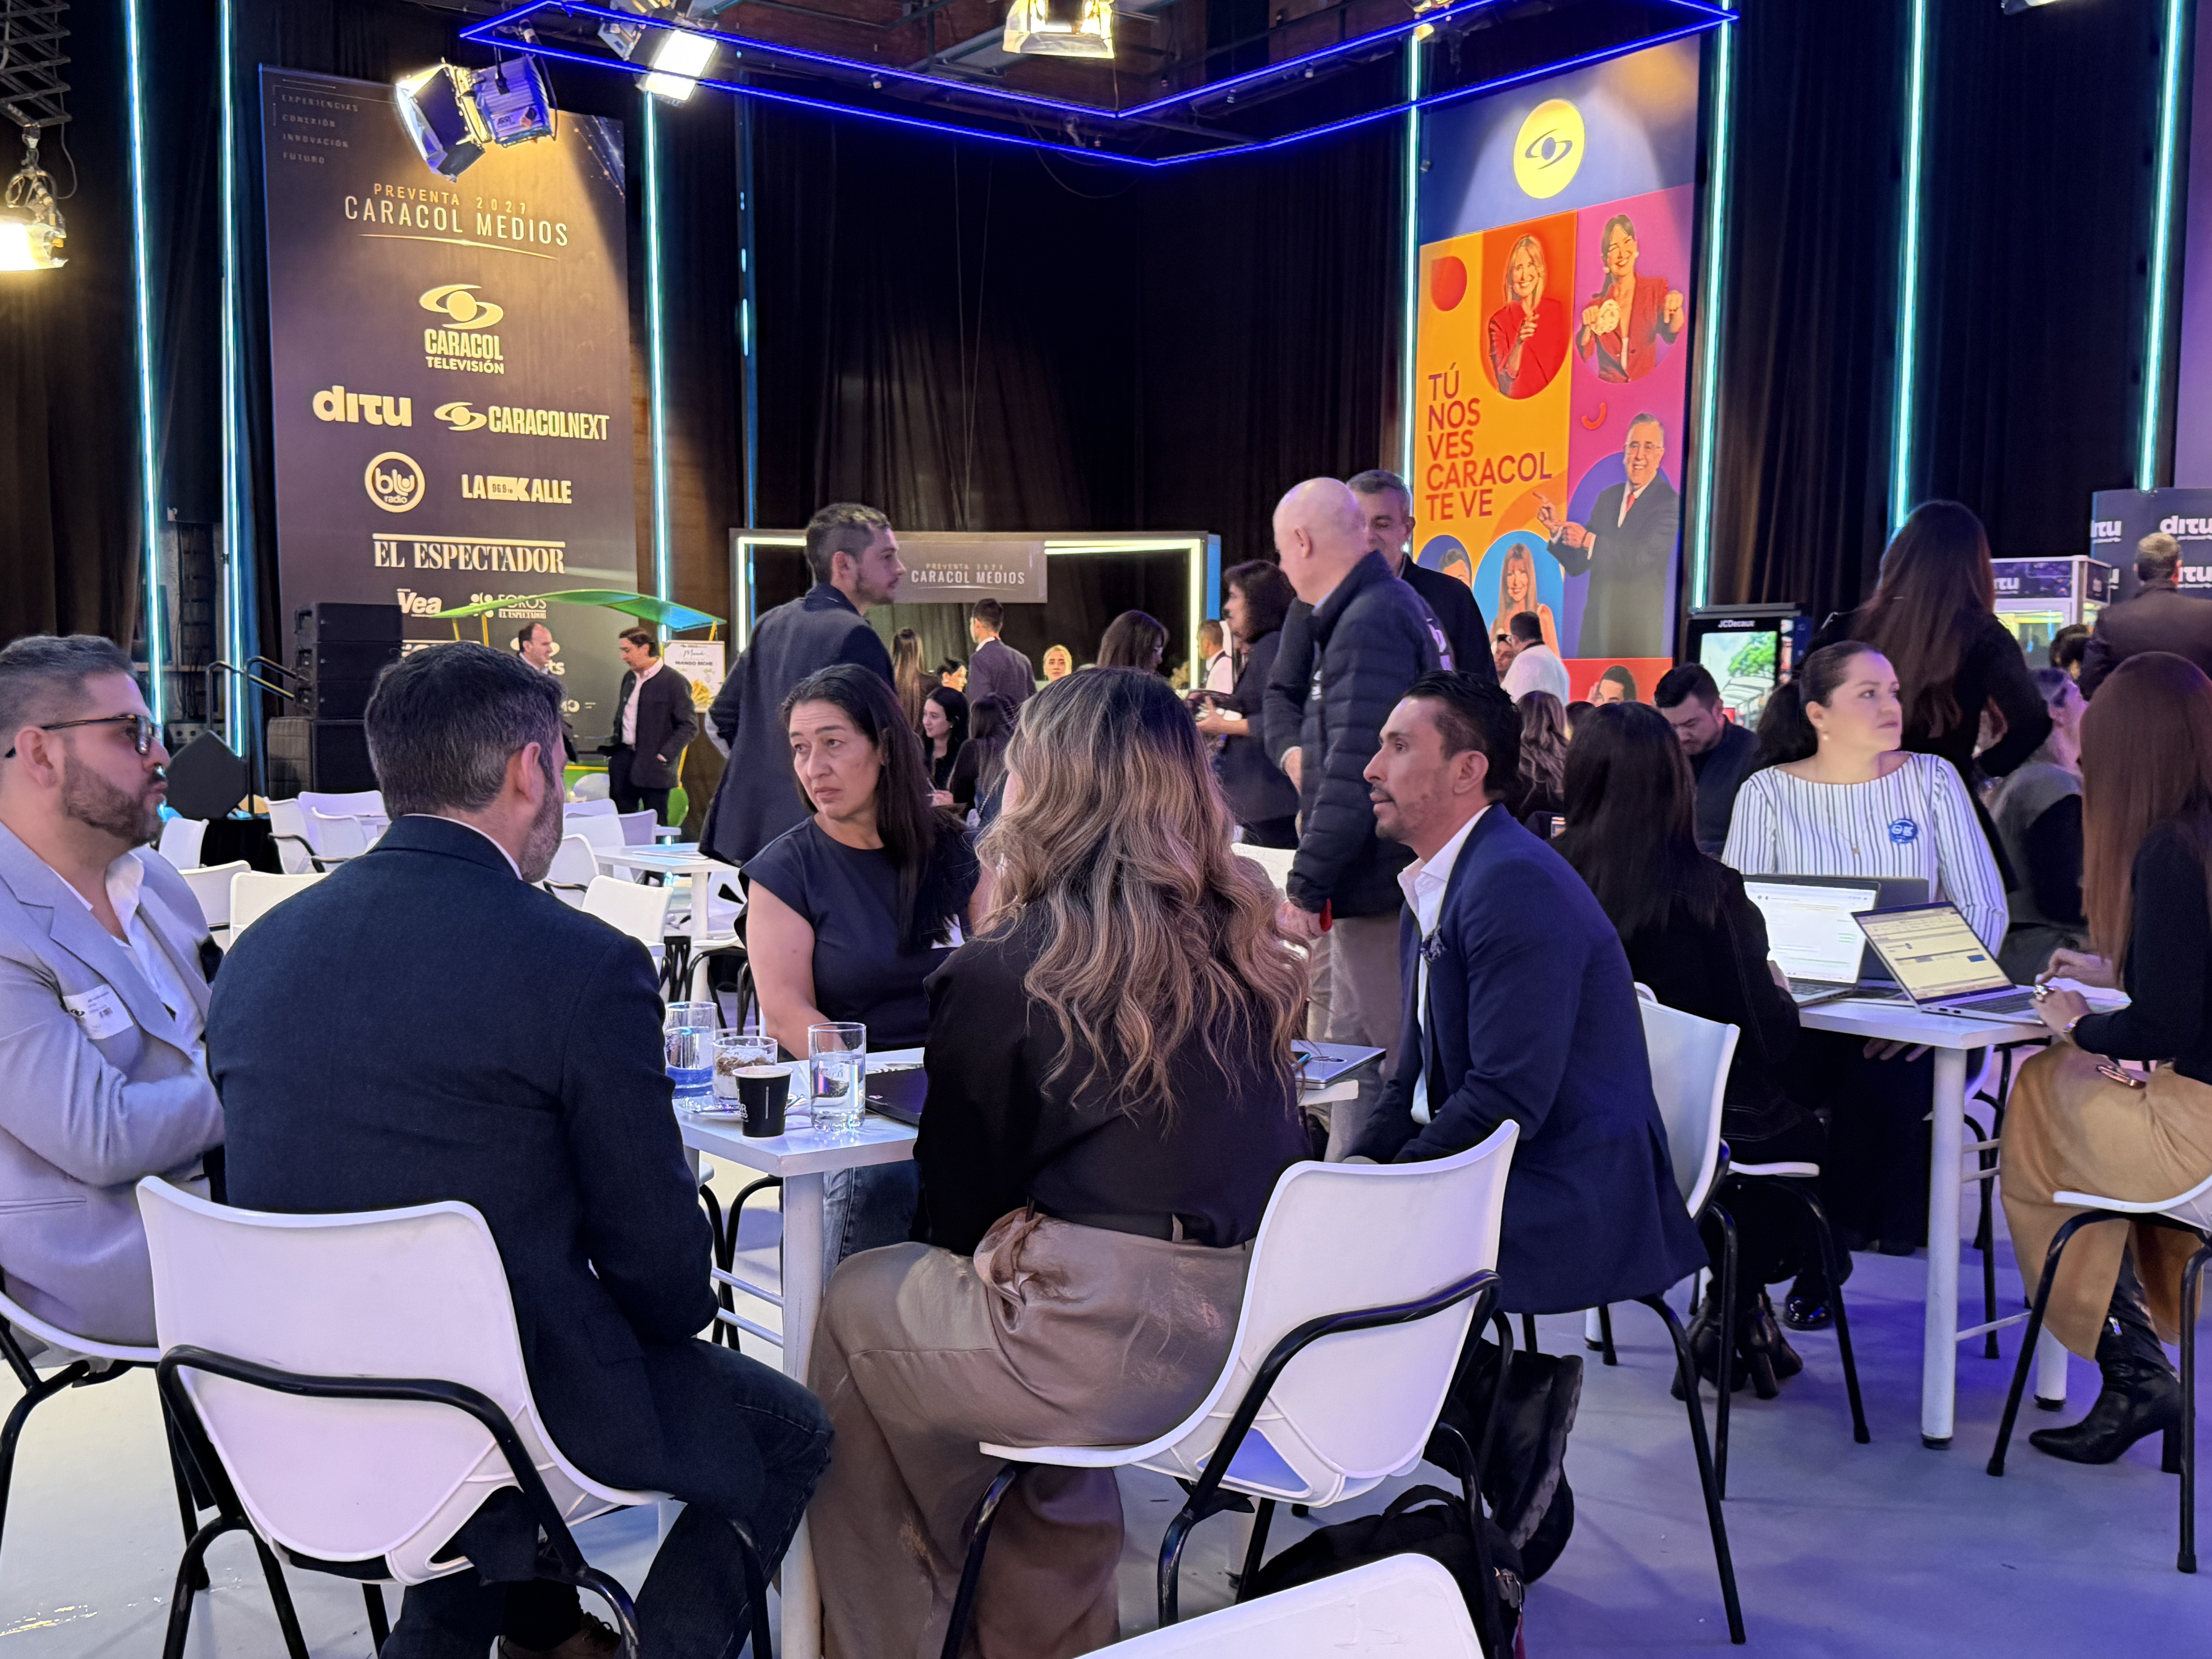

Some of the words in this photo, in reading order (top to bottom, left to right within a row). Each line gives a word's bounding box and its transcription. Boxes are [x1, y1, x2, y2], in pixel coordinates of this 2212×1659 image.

[374, 184, 460, 206] PREVENTA
[476, 197, 526, 214] 2027
[345, 196, 463, 233] CARACOL
[477, 213, 568, 246] MEDIOS
[424, 329, 503, 360] CARACOL
[425, 356, 505, 374] TELEVISIÓN
[1428, 362, 1460, 401] TÚ
[488, 405, 610, 440] CARACOLNEXT
[1428, 398, 1481, 432] NOS
[1427, 429, 1474, 461] VES
[461, 474, 487, 499] LA
[1427, 452, 1553, 491] CARACOL
[384, 495, 408, 504] radio
[1425, 493, 1454, 521] TE
[1460, 489, 1493, 518] VE
[374, 541, 405, 568] EL
[414, 543, 566, 574] ESPECTADOR
[911, 570, 970, 584] CARACOL
[976, 570, 1025, 584] MEDIOS
[2178, 567, 2212, 582] itu
[397, 592, 442, 614] Vea
